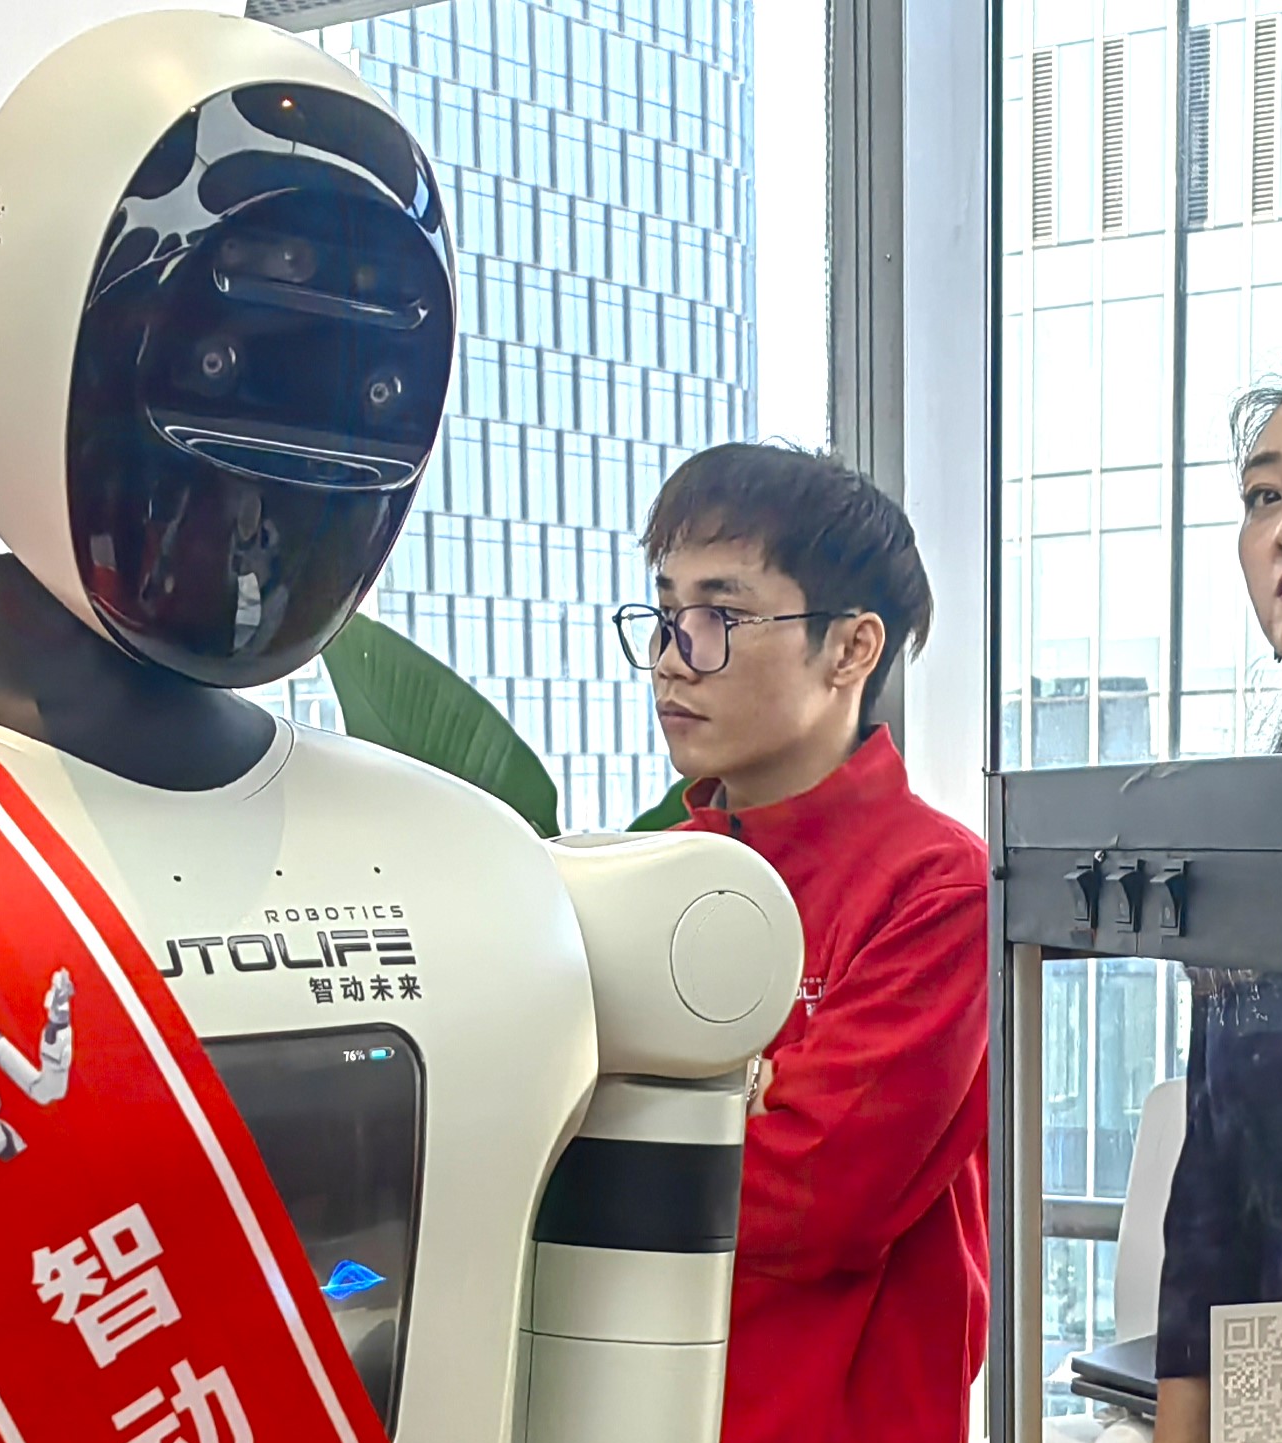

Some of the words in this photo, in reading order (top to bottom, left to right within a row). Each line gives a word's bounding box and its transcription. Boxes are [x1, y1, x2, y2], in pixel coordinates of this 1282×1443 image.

[264, 905, 404, 924] ROBOTICS
[309, 973, 423, 1004] 智动未来
[343, 1050, 366, 1062] 76%
